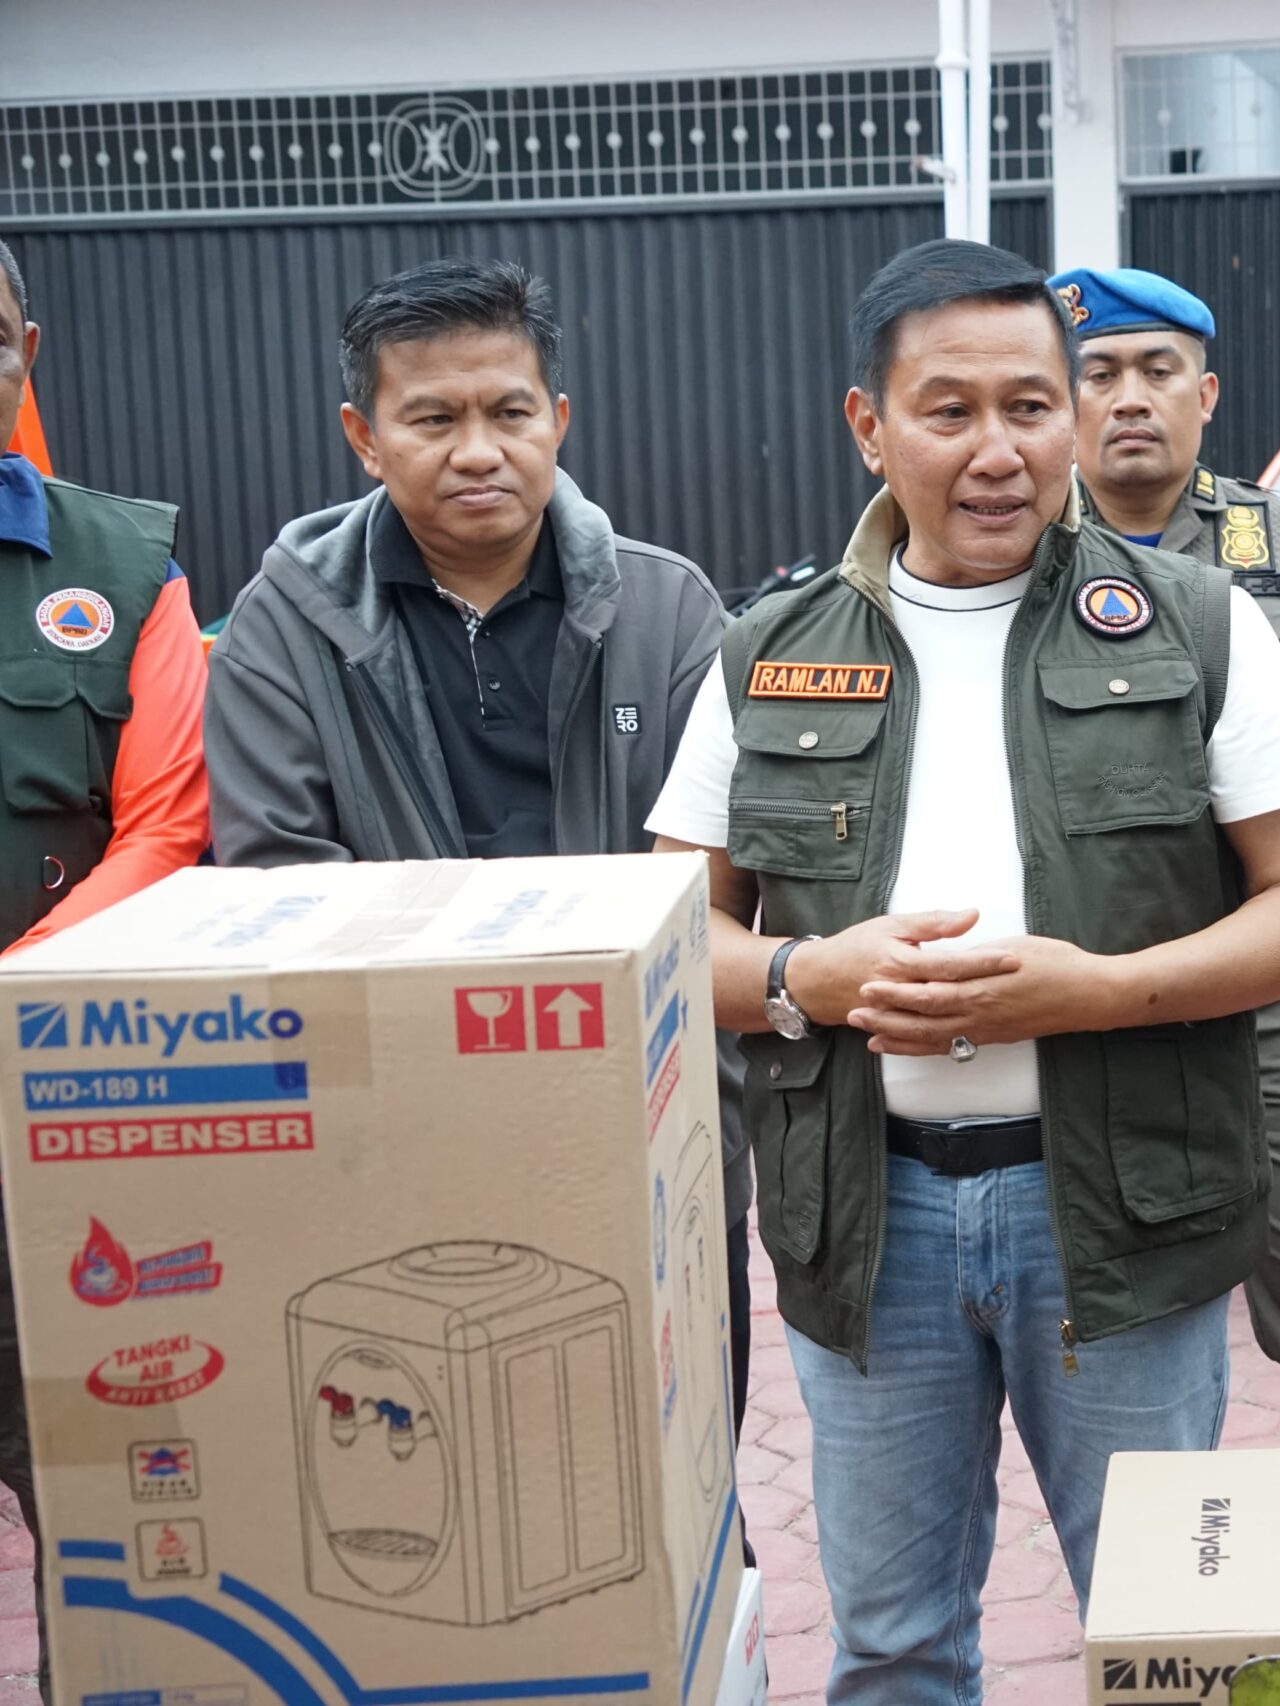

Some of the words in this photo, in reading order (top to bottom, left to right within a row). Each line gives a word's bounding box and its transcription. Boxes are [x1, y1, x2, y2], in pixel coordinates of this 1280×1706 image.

[758, 667, 851, 693] RAMLAN
[856, 669, 878, 693] N.
[80, 992, 304, 1059] Miyako
[28, 1075, 140, 1104] WD-189
[146, 1074, 169, 1099] H
[35, 1118, 309, 1157] DISPENSER
[113, 1334, 191, 1368] TANGKI
[140, 1360, 174, 1382] AIR
[1190, 1514, 1231, 1576] Miyako
[1144, 1653, 1257, 1698] Miy
